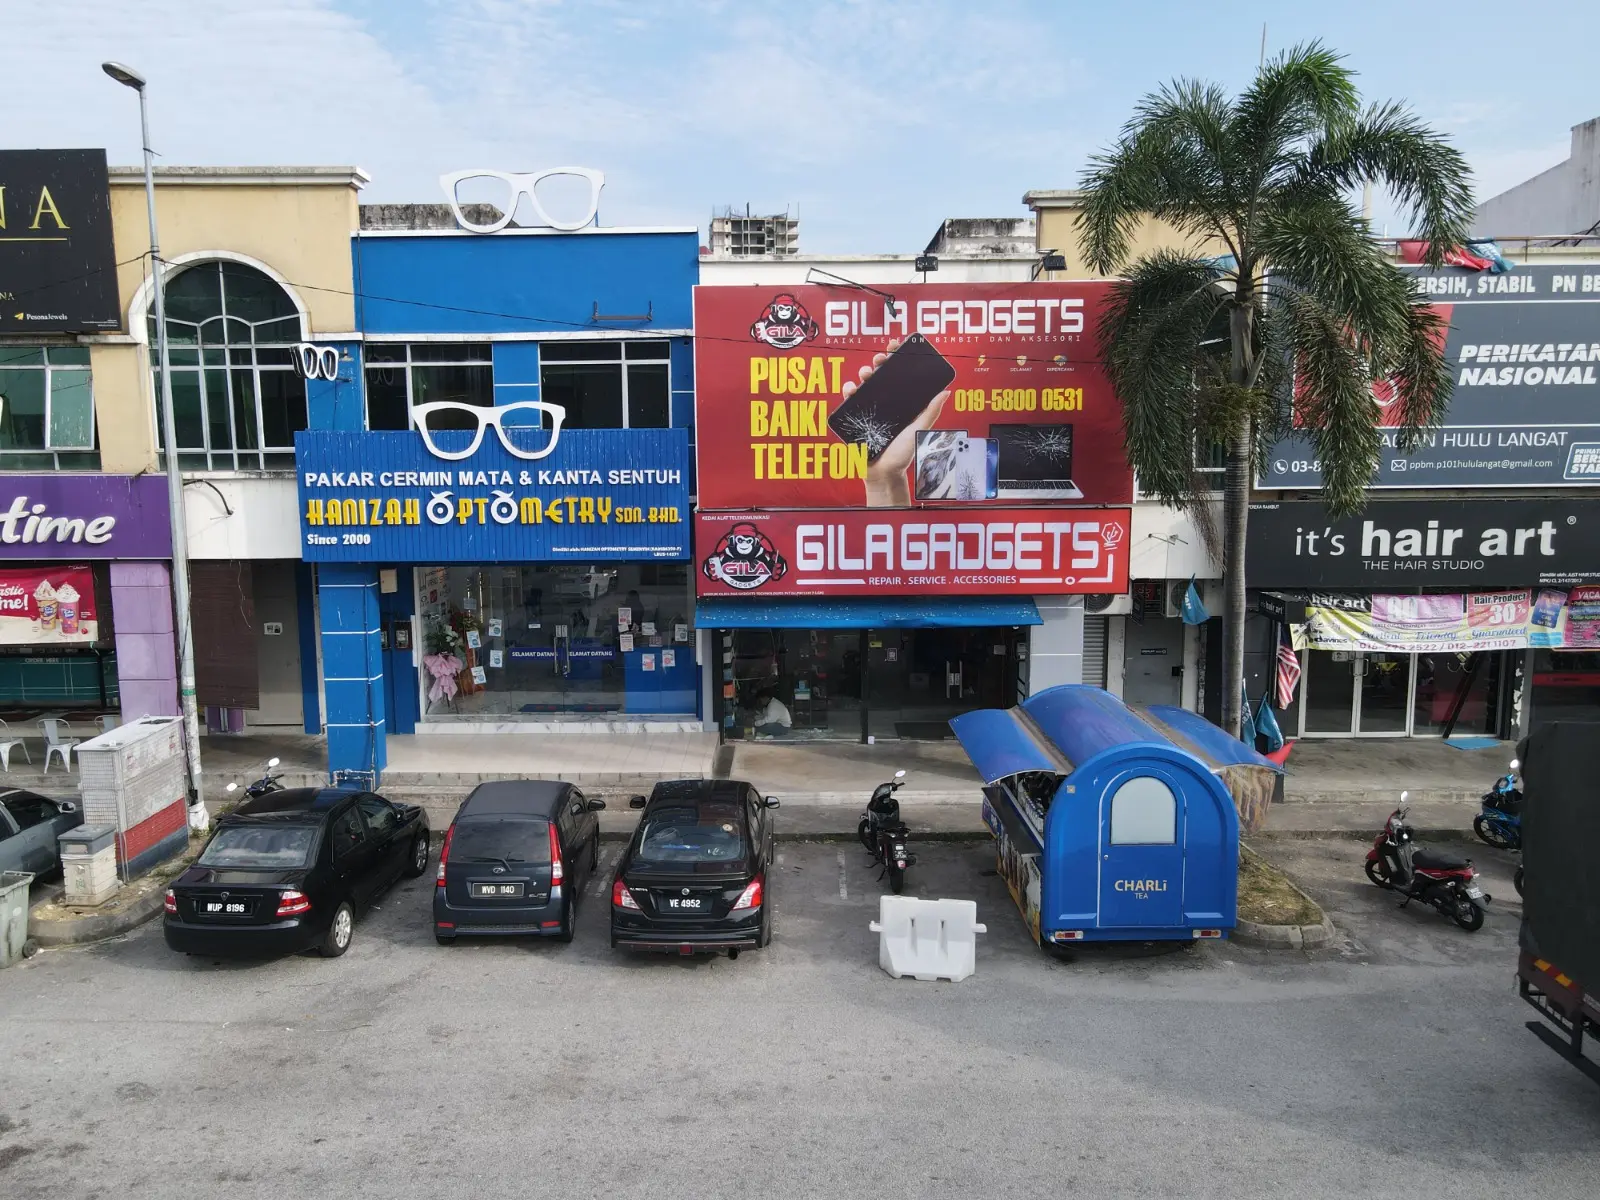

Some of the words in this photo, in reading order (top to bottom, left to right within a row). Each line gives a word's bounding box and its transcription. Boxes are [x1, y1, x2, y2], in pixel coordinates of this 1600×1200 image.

[1478, 275, 1536, 294] STABIL
[1551, 275, 1577, 293] PN
[825, 300, 908, 336] GILA
[917, 298, 1084, 335] GADGETS
[765, 325, 807, 339] GILA
[750, 356, 845, 394] PUSAT
[1458, 366, 1597, 386] NASIONAL
[955, 389, 1036, 411] 019-5800
[1041, 388, 1083, 411] 0531
[750, 400, 828, 437] BAIKI
[1443, 432, 1491, 447] HULU
[1498, 431, 1568, 446] LANGAT
[750, 442, 868, 480] TELEFON
[305, 472, 374, 487] PAKAR
[380, 471, 452, 486] CERMIN
[458, 470, 513, 486] MATA
[518, 470, 532, 486] &
[538, 470, 602, 485] KANTA
[608, 469, 681, 485] SENTUH
[305, 498, 421, 526] HANIZAH
[615, 506, 645, 523] SDN.
[647, 507, 682, 523] BHD.
[307, 534, 338, 545] Since
[342, 534, 371, 545] 2000
[796, 523, 894, 571] GILA
[901, 522, 1100, 571] GADGETS
[1296, 527, 1345, 556] it's
[1361, 520, 1464, 557] hair
[1479, 520, 1557, 557] art
[721, 560, 772, 577] GILA
[1363, 560, 1389, 570] THE
[1394, 560, 1427, 570] HAIR
[1432, 559, 1485, 570] STUDIO
[869, 577, 901, 585] REPAIR
[908, 576, 946, 585] SERVICE
[953, 575, 1017, 584] ACCESSORIES
[1344, 599, 1366, 609] art
[1474, 595, 1492, 605] Hair
[1493, 593, 1527, 603] Product
[481, 886, 495, 894] WVD
[500, 886, 515, 894] 1140
[1134, 892, 1149, 900] TEA
[207, 903, 223, 912] WUP
[226, 903, 245, 913] 8196
[669, 899, 679, 908] VE
[681, 899, 701, 908] 4952
